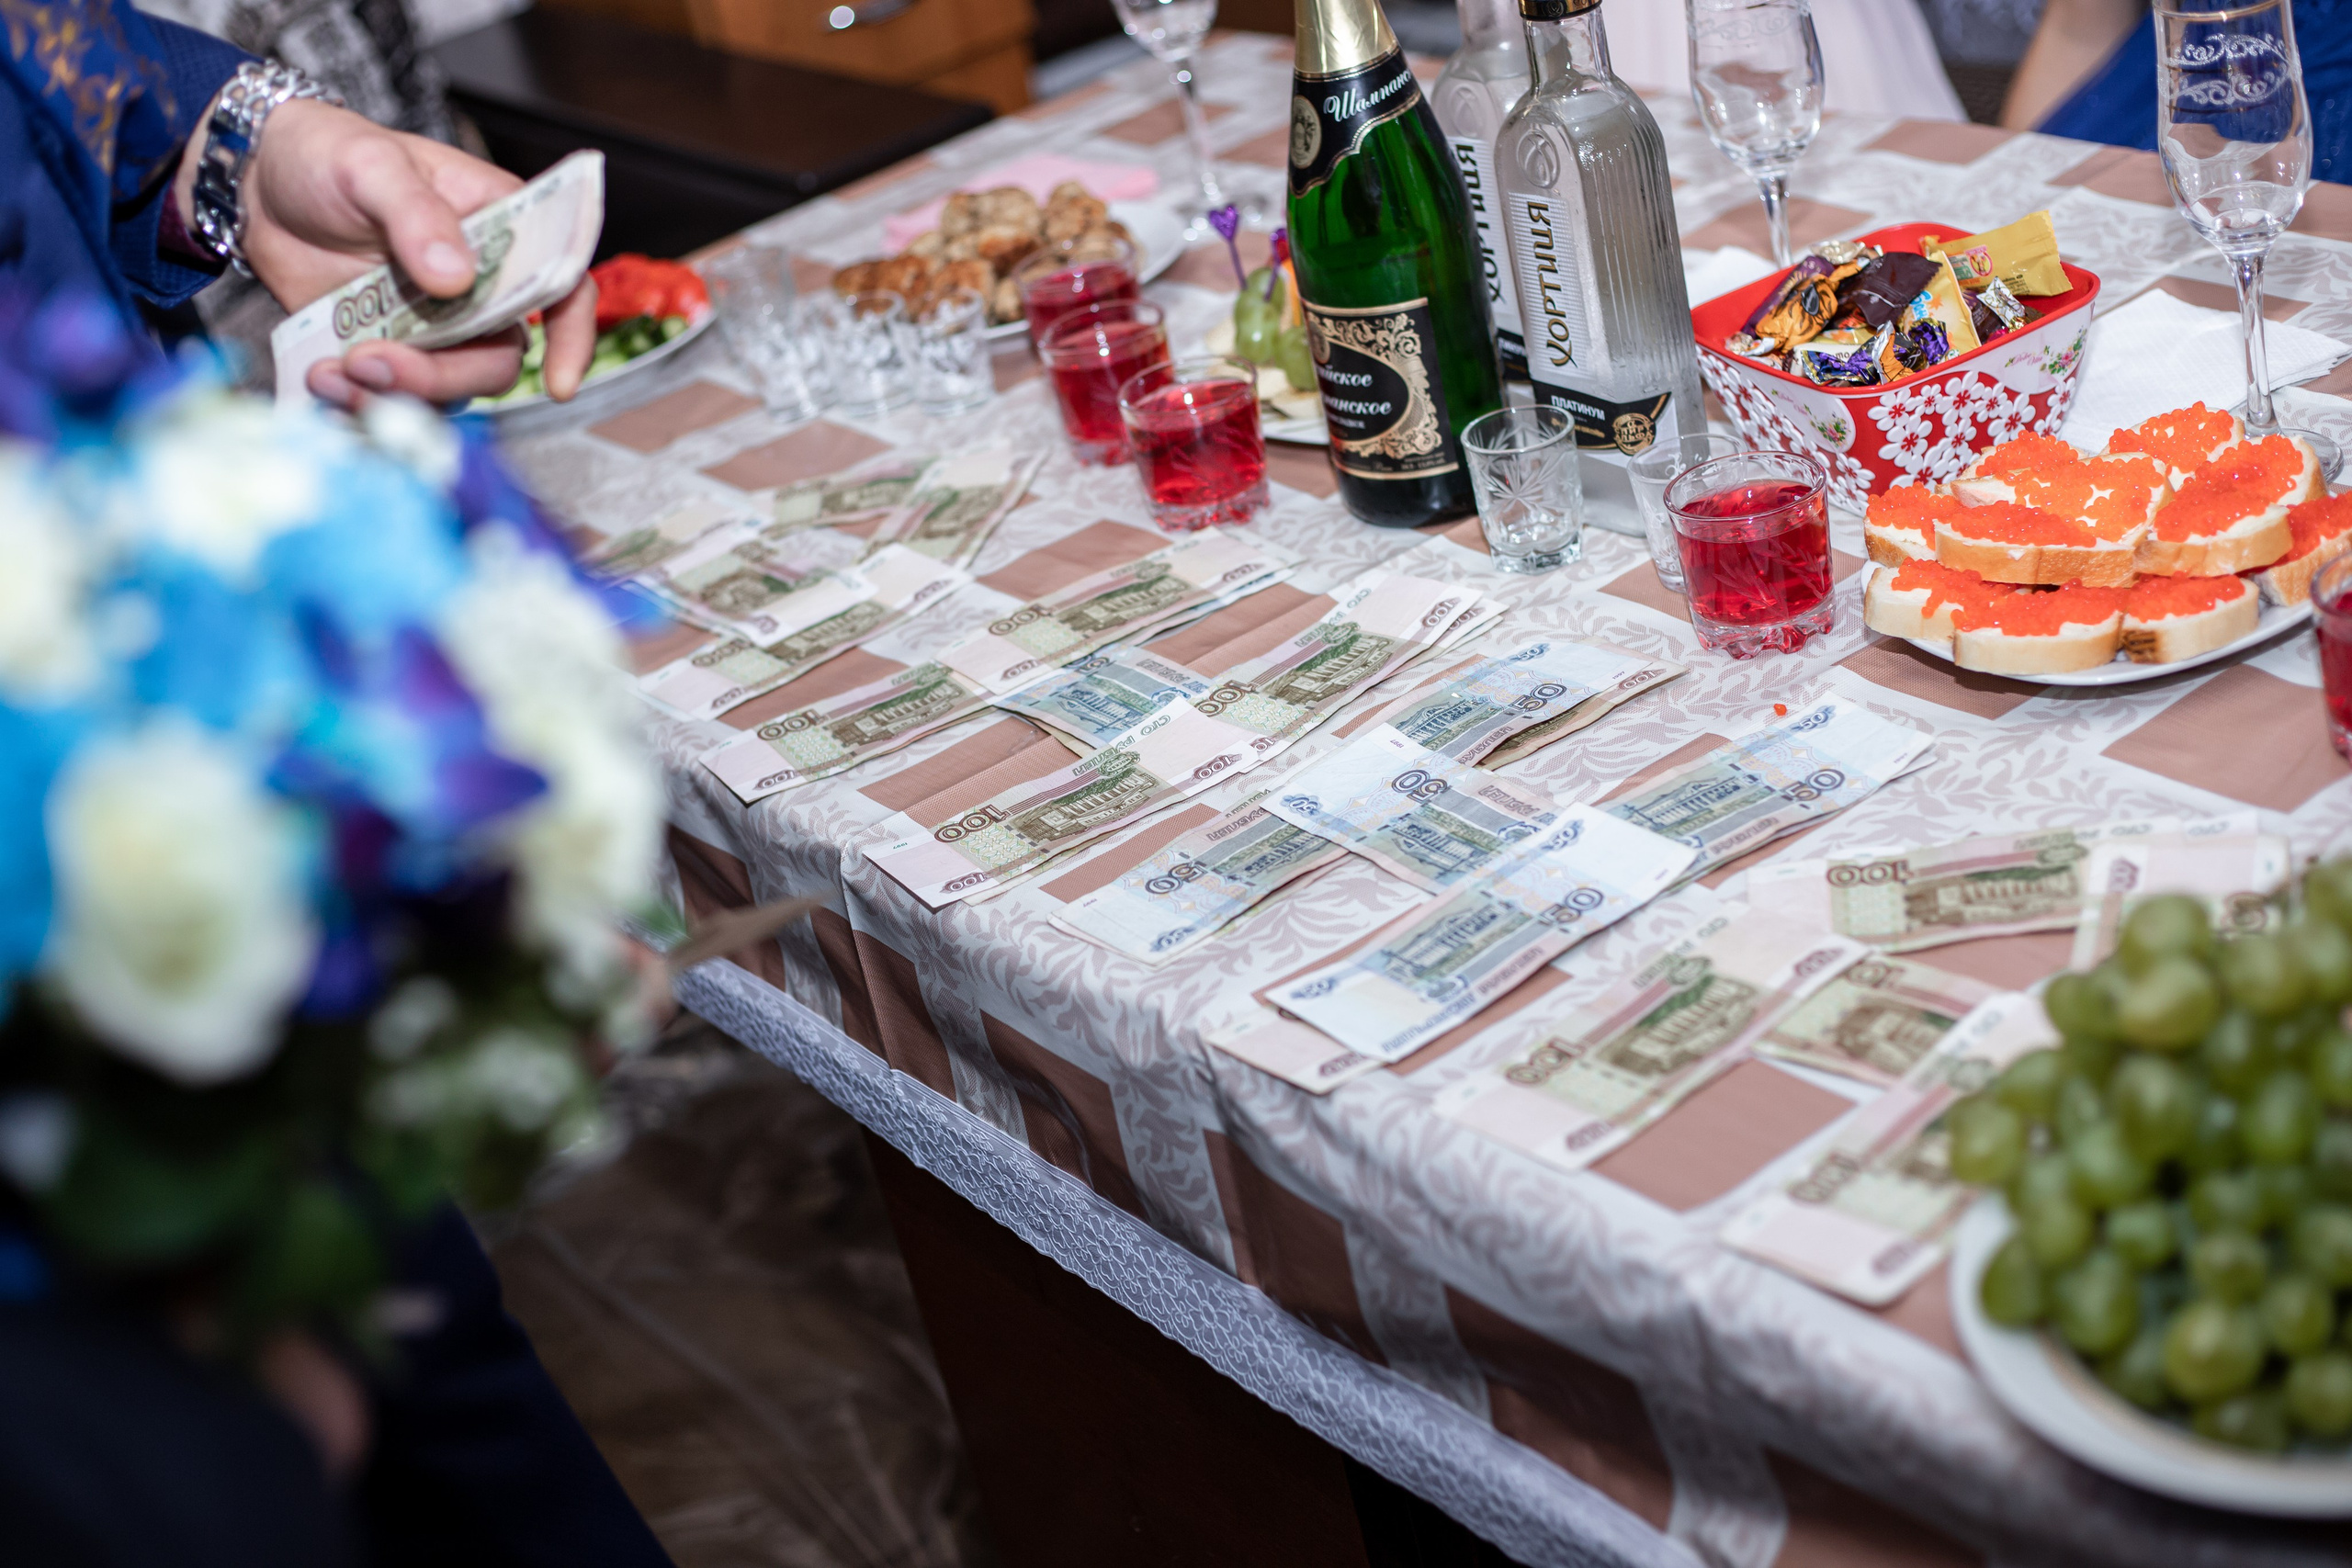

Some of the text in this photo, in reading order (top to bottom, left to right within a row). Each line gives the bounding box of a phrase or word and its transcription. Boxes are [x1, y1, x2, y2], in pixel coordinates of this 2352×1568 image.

[1527, 200, 1578, 368] ХОРТИЦЯ
[332, 275, 399, 341] 100
[1551, 395, 1605, 421] ПЛАТИНУМ
[1424, 601, 1453, 628] 100
[1518, 647, 1544, 661] 50
[1621, 670, 1659, 691] 100
[1510, 682, 1568, 713] 50
[757, 709, 829, 741] 100
[1073, 715, 1171, 777] СТО РУБЛЕЙ
[1199, 756, 1232, 780] 100
[1784, 768, 1846, 801] 50
[1390, 769, 1448, 804] 50
[1478, 784, 1541, 818] РУБЛЕЙ
[933, 805, 1009, 843] 100
[949, 873, 986, 891] 100
[1145, 861, 1207, 895] 50
[1539, 886, 1605, 926] 50
